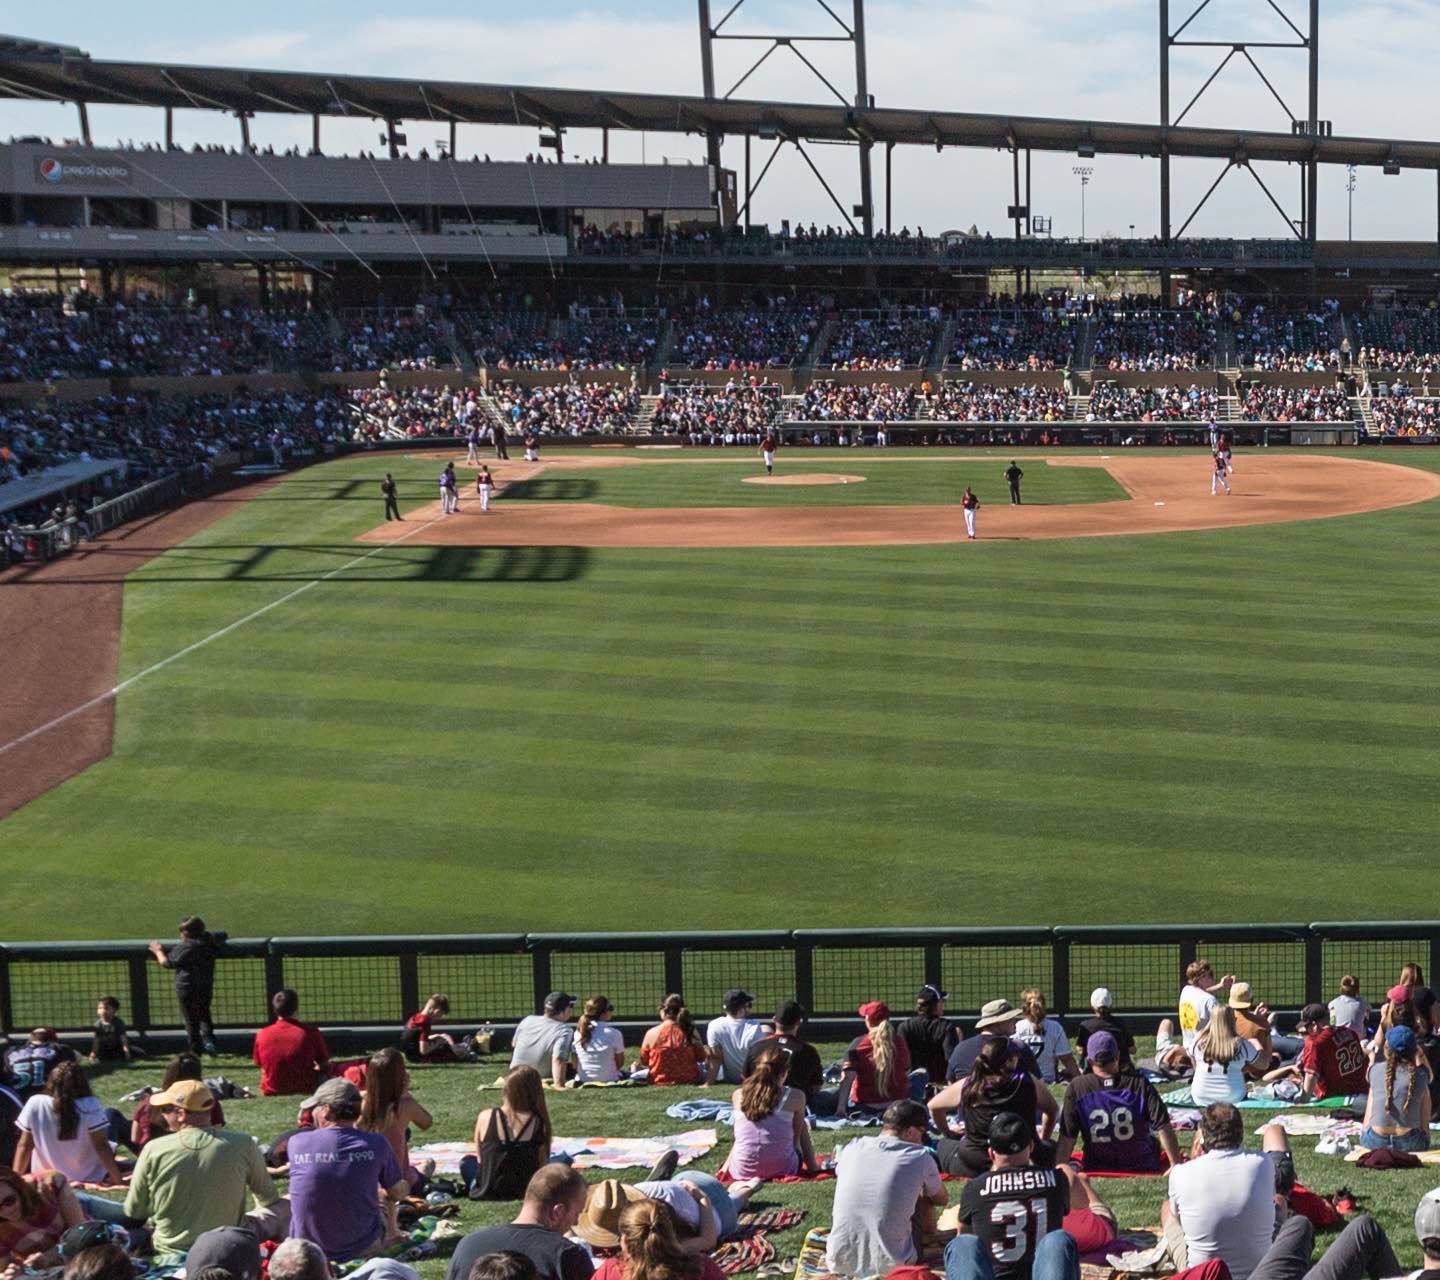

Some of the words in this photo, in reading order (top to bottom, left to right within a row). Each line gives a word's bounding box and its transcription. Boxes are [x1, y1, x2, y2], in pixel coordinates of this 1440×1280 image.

[12, 1060, 46, 1090] 51
[1335, 1042, 1363, 1077] 22
[1089, 1107, 1135, 1143] 28
[979, 1170, 1057, 1197] JOHNSON
[991, 1198, 1049, 1263] 31
